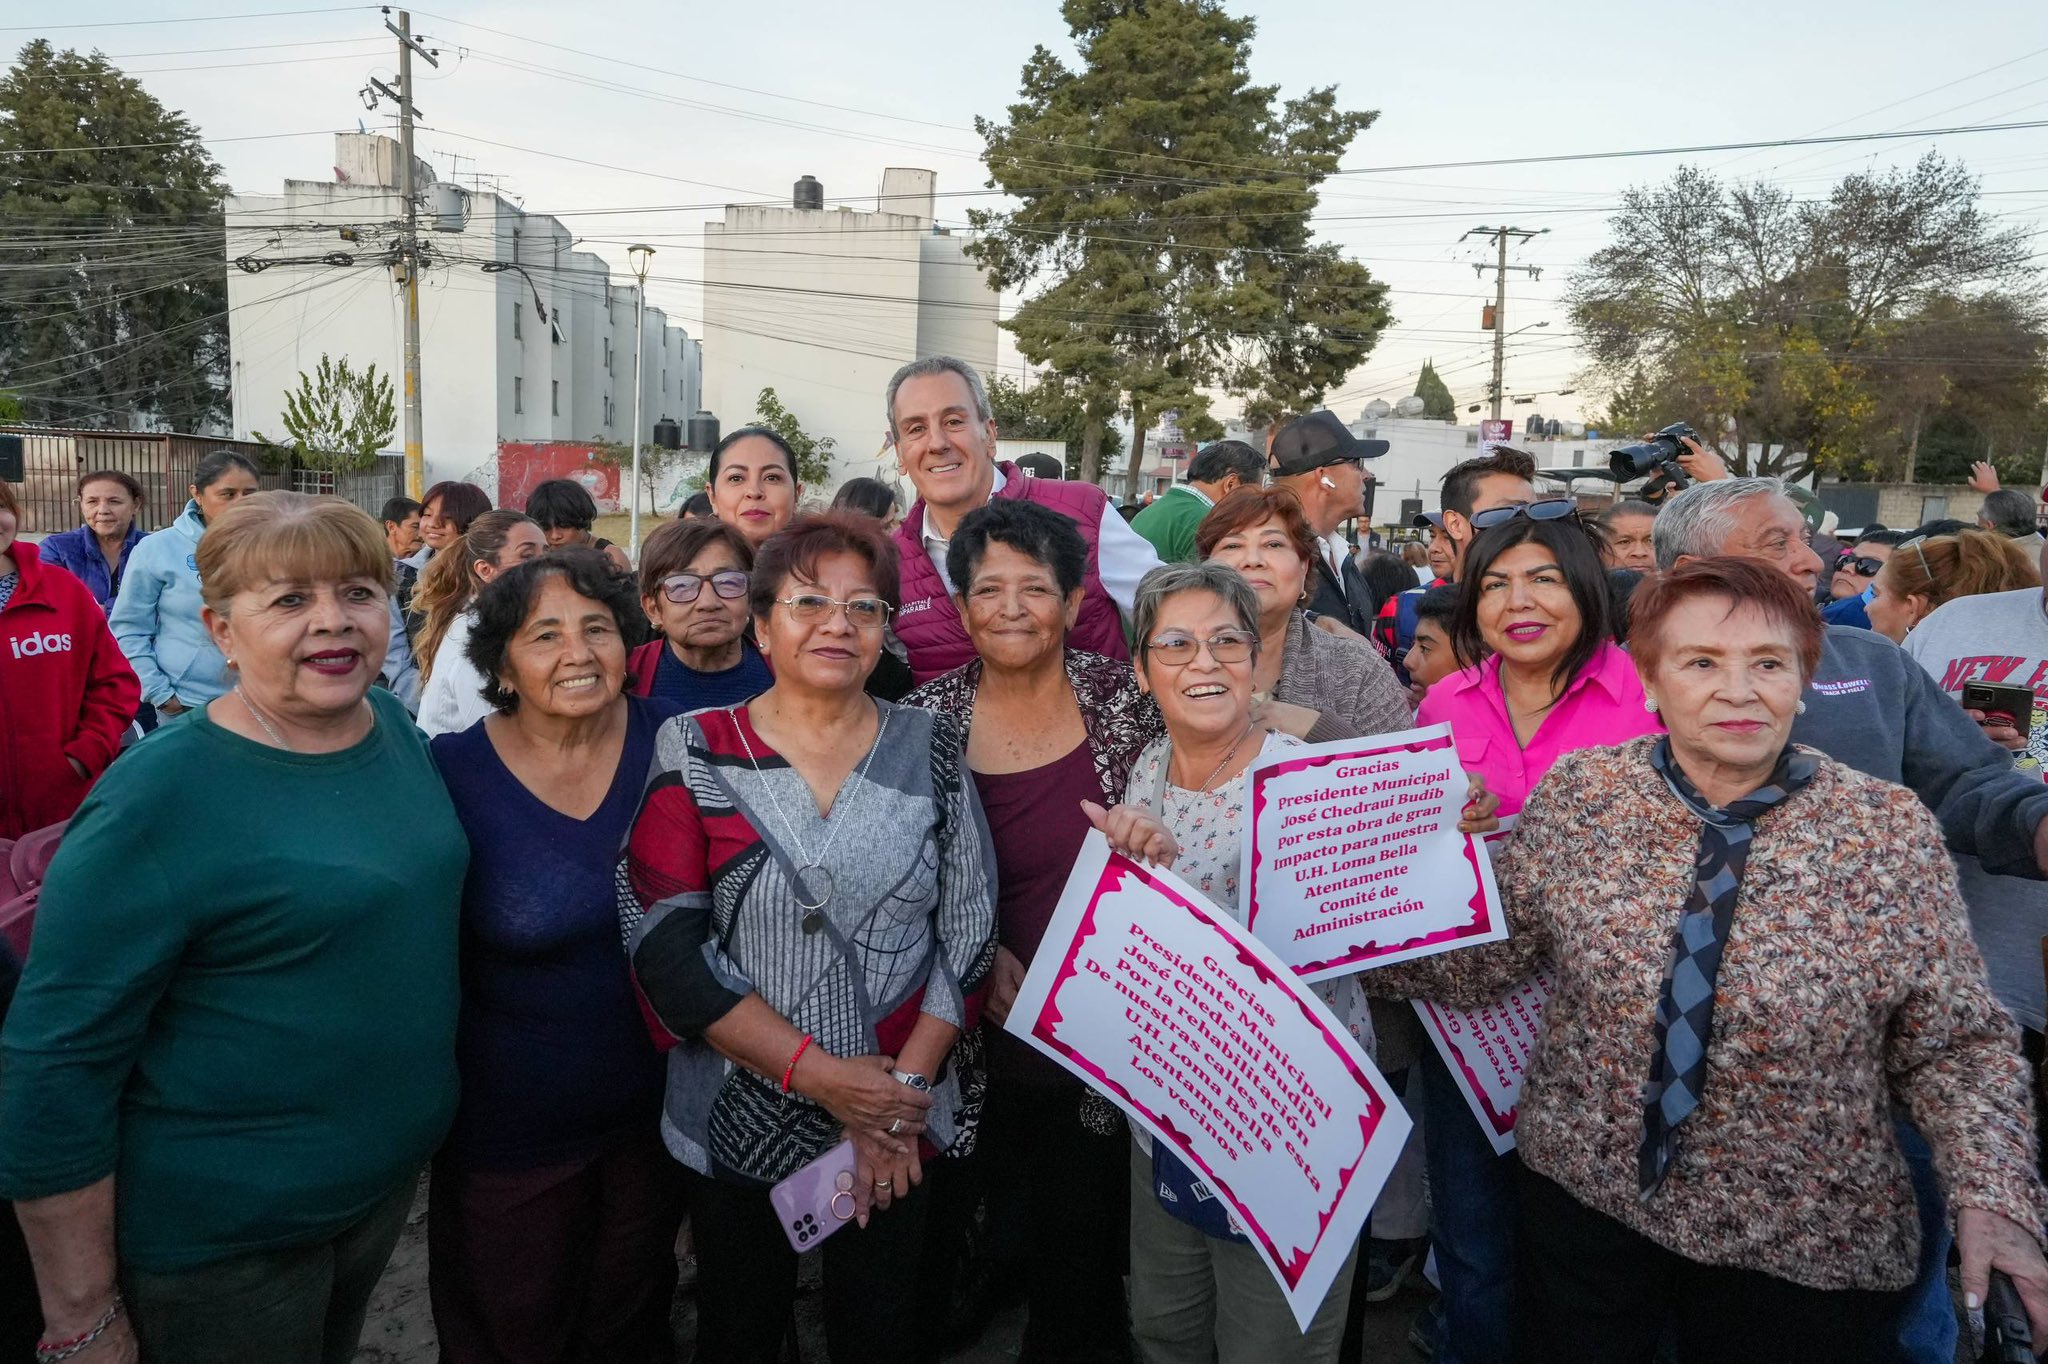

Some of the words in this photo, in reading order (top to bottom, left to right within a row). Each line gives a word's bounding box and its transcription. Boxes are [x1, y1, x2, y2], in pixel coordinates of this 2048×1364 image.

[9, 631, 72, 659] idas
[1940, 655, 2027, 692] NEW
[1278, 785, 1369, 811] Presidente
[1373, 768, 1451, 791] Municipal
[1336, 761, 1400, 778] Gracias
[1277, 833, 1303, 851] Por
[1307, 827, 1343, 842] esta
[1346, 818, 1383, 834] obra
[1386, 812, 1402, 824] de
[1406, 806, 1442, 823] gran
[1281, 810, 1317, 829] José
[1321, 797, 1395, 820] Chedraui
[1398, 788, 1444, 805] Budib
[1273, 846, 1338, 870] Impacto
[1342, 837, 1379, 854] para
[1382, 824, 1439, 842] nuestra
[1294, 864, 1329, 883] U.H.
[1332, 854, 1376, 873] Loma
[1380, 843, 1418, 861] Bella
[1304, 866, 1409, 899] Atentamente
[1320, 889, 1376, 914] Comité
[1380, 885, 1398, 899] de
[1294, 901, 1425, 941] Administración
[1203, 955, 1276, 1027] Gracias
[1124, 946, 1171, 980] José
[1174, 979, 1261, 1062] Chedraui
[1263, 1061, 1317, 1129] Budib
[1130, 923, 1235, 1011] Presidente
[1238, 1011, 1333, 1120] Municipal
[1116, 959, 1152, 988] Por
[1155, 985, 1174, 1007] la
[1178, 1006, 1309, 1146] rehabilitación
[1493, 1034, 1524, 1075] José
[1085, 959, 1111, 980] De
[1115, 981, 1201, 1053] nuestras
[1204, 1053, 1258, 1110] calles
[1260, 1111, 1283, 1137] de
[1285, 1140, 1321, 1192] esta
[1125, 1006, 1164, 1045] U.H.
[1169, 1042, 1222, 1097] Loma
[1226, 1095, 1273, 1152] Bella
[1129, 1035, 1254, 1152] Atentamente
[1131, 1056, 1164, 1088] Los
[1168, 1087, 1237, 1160] vecinos
